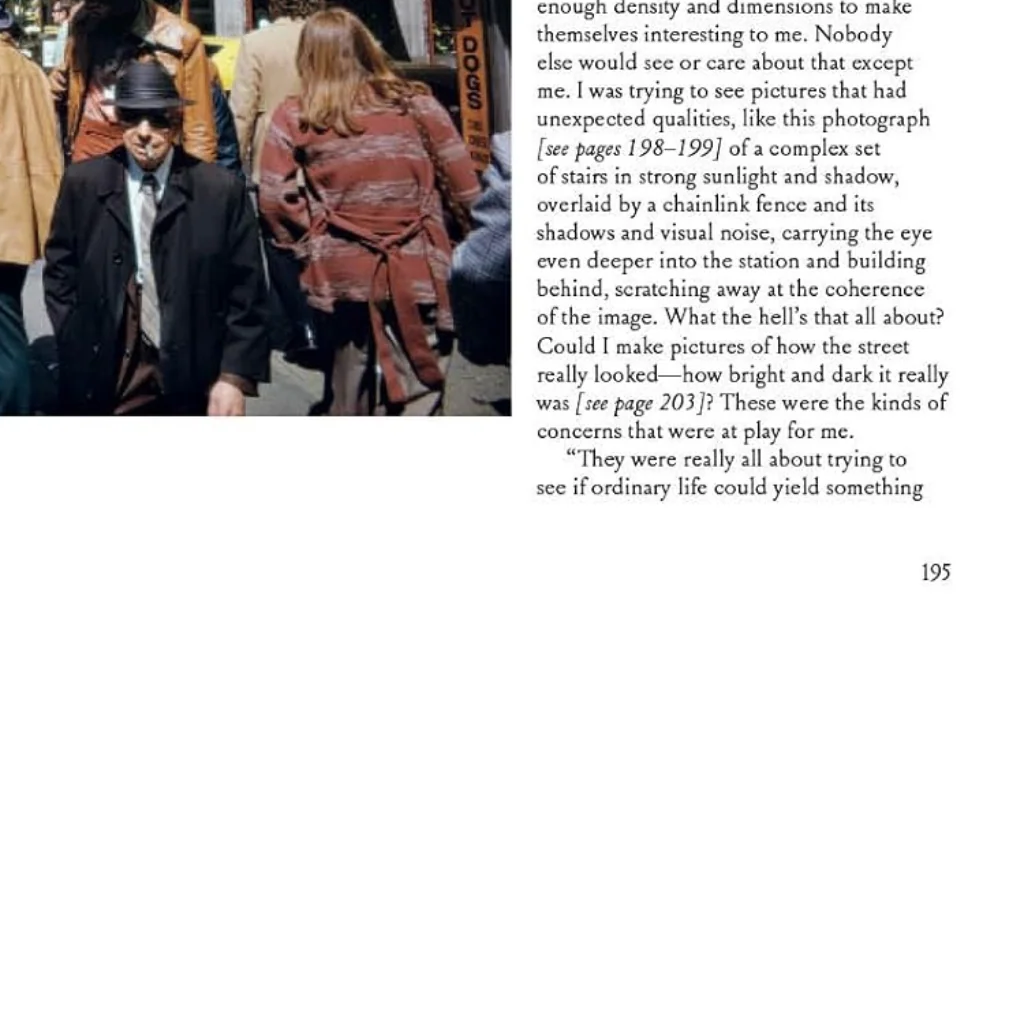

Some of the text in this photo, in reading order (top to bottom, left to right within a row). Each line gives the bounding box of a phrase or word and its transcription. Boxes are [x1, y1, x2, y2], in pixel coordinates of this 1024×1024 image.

[839, 0, 859, 15] to
[537, 23, 893, 49] themselves interesting to me. Nobody
[462, 36, 483, 111] DOGS
[537, 107, 930, 134] unexpected qualities, like this photograph
[537, 192, 875, 219] overlaid by a chainlink fence and its
[537, 249, 926, 275] even deeper into the station and building
[537, 277, 925, 304] behind, scratching away at the coherence
[537, 419, 854, 446] concerns that were at play for me.
[922, 563, 951, 582] 195
